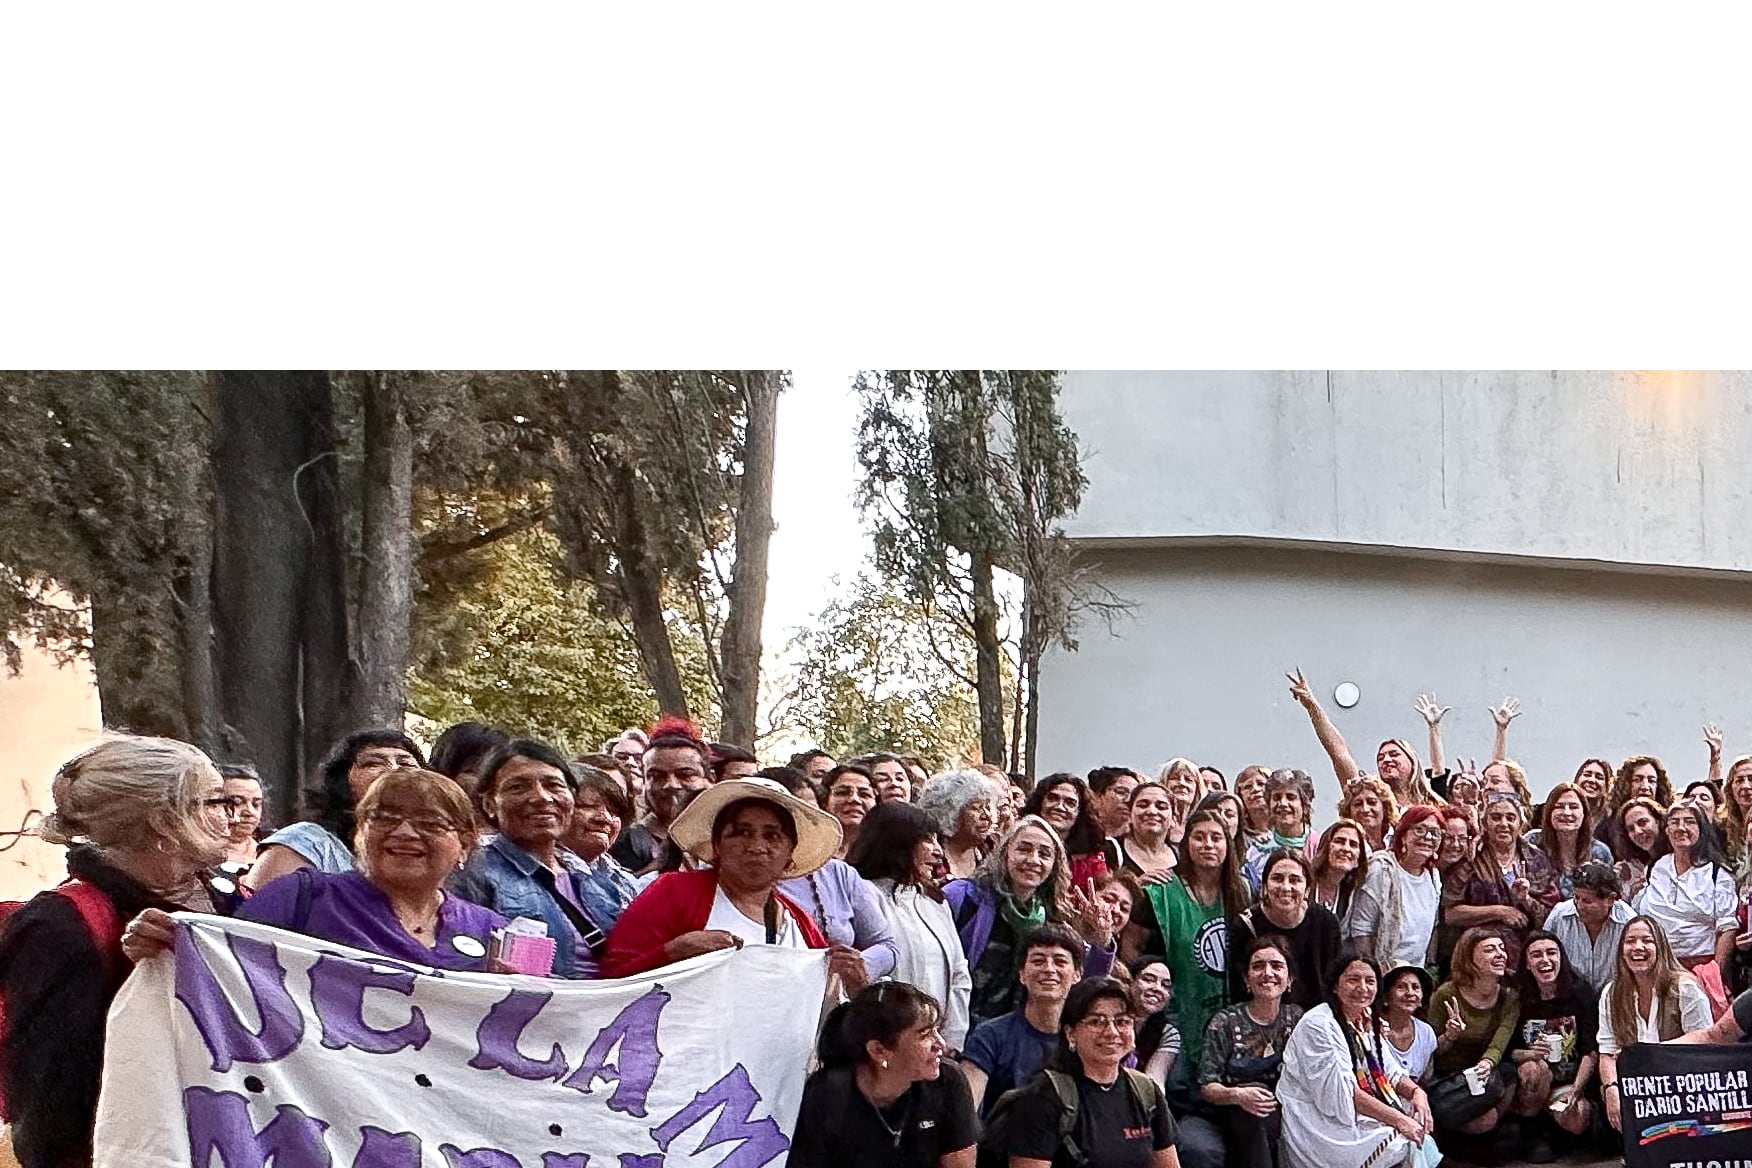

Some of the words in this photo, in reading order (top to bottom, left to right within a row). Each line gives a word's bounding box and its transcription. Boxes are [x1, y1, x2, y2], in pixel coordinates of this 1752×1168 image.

[468, 982, 673, 1119] LA
[1621, 1075, 1673, 1097] FRENTE
[1676, 1070, 1748, 1094] POPULAR
[1634, 1094, 1682, 1119] DARIO
